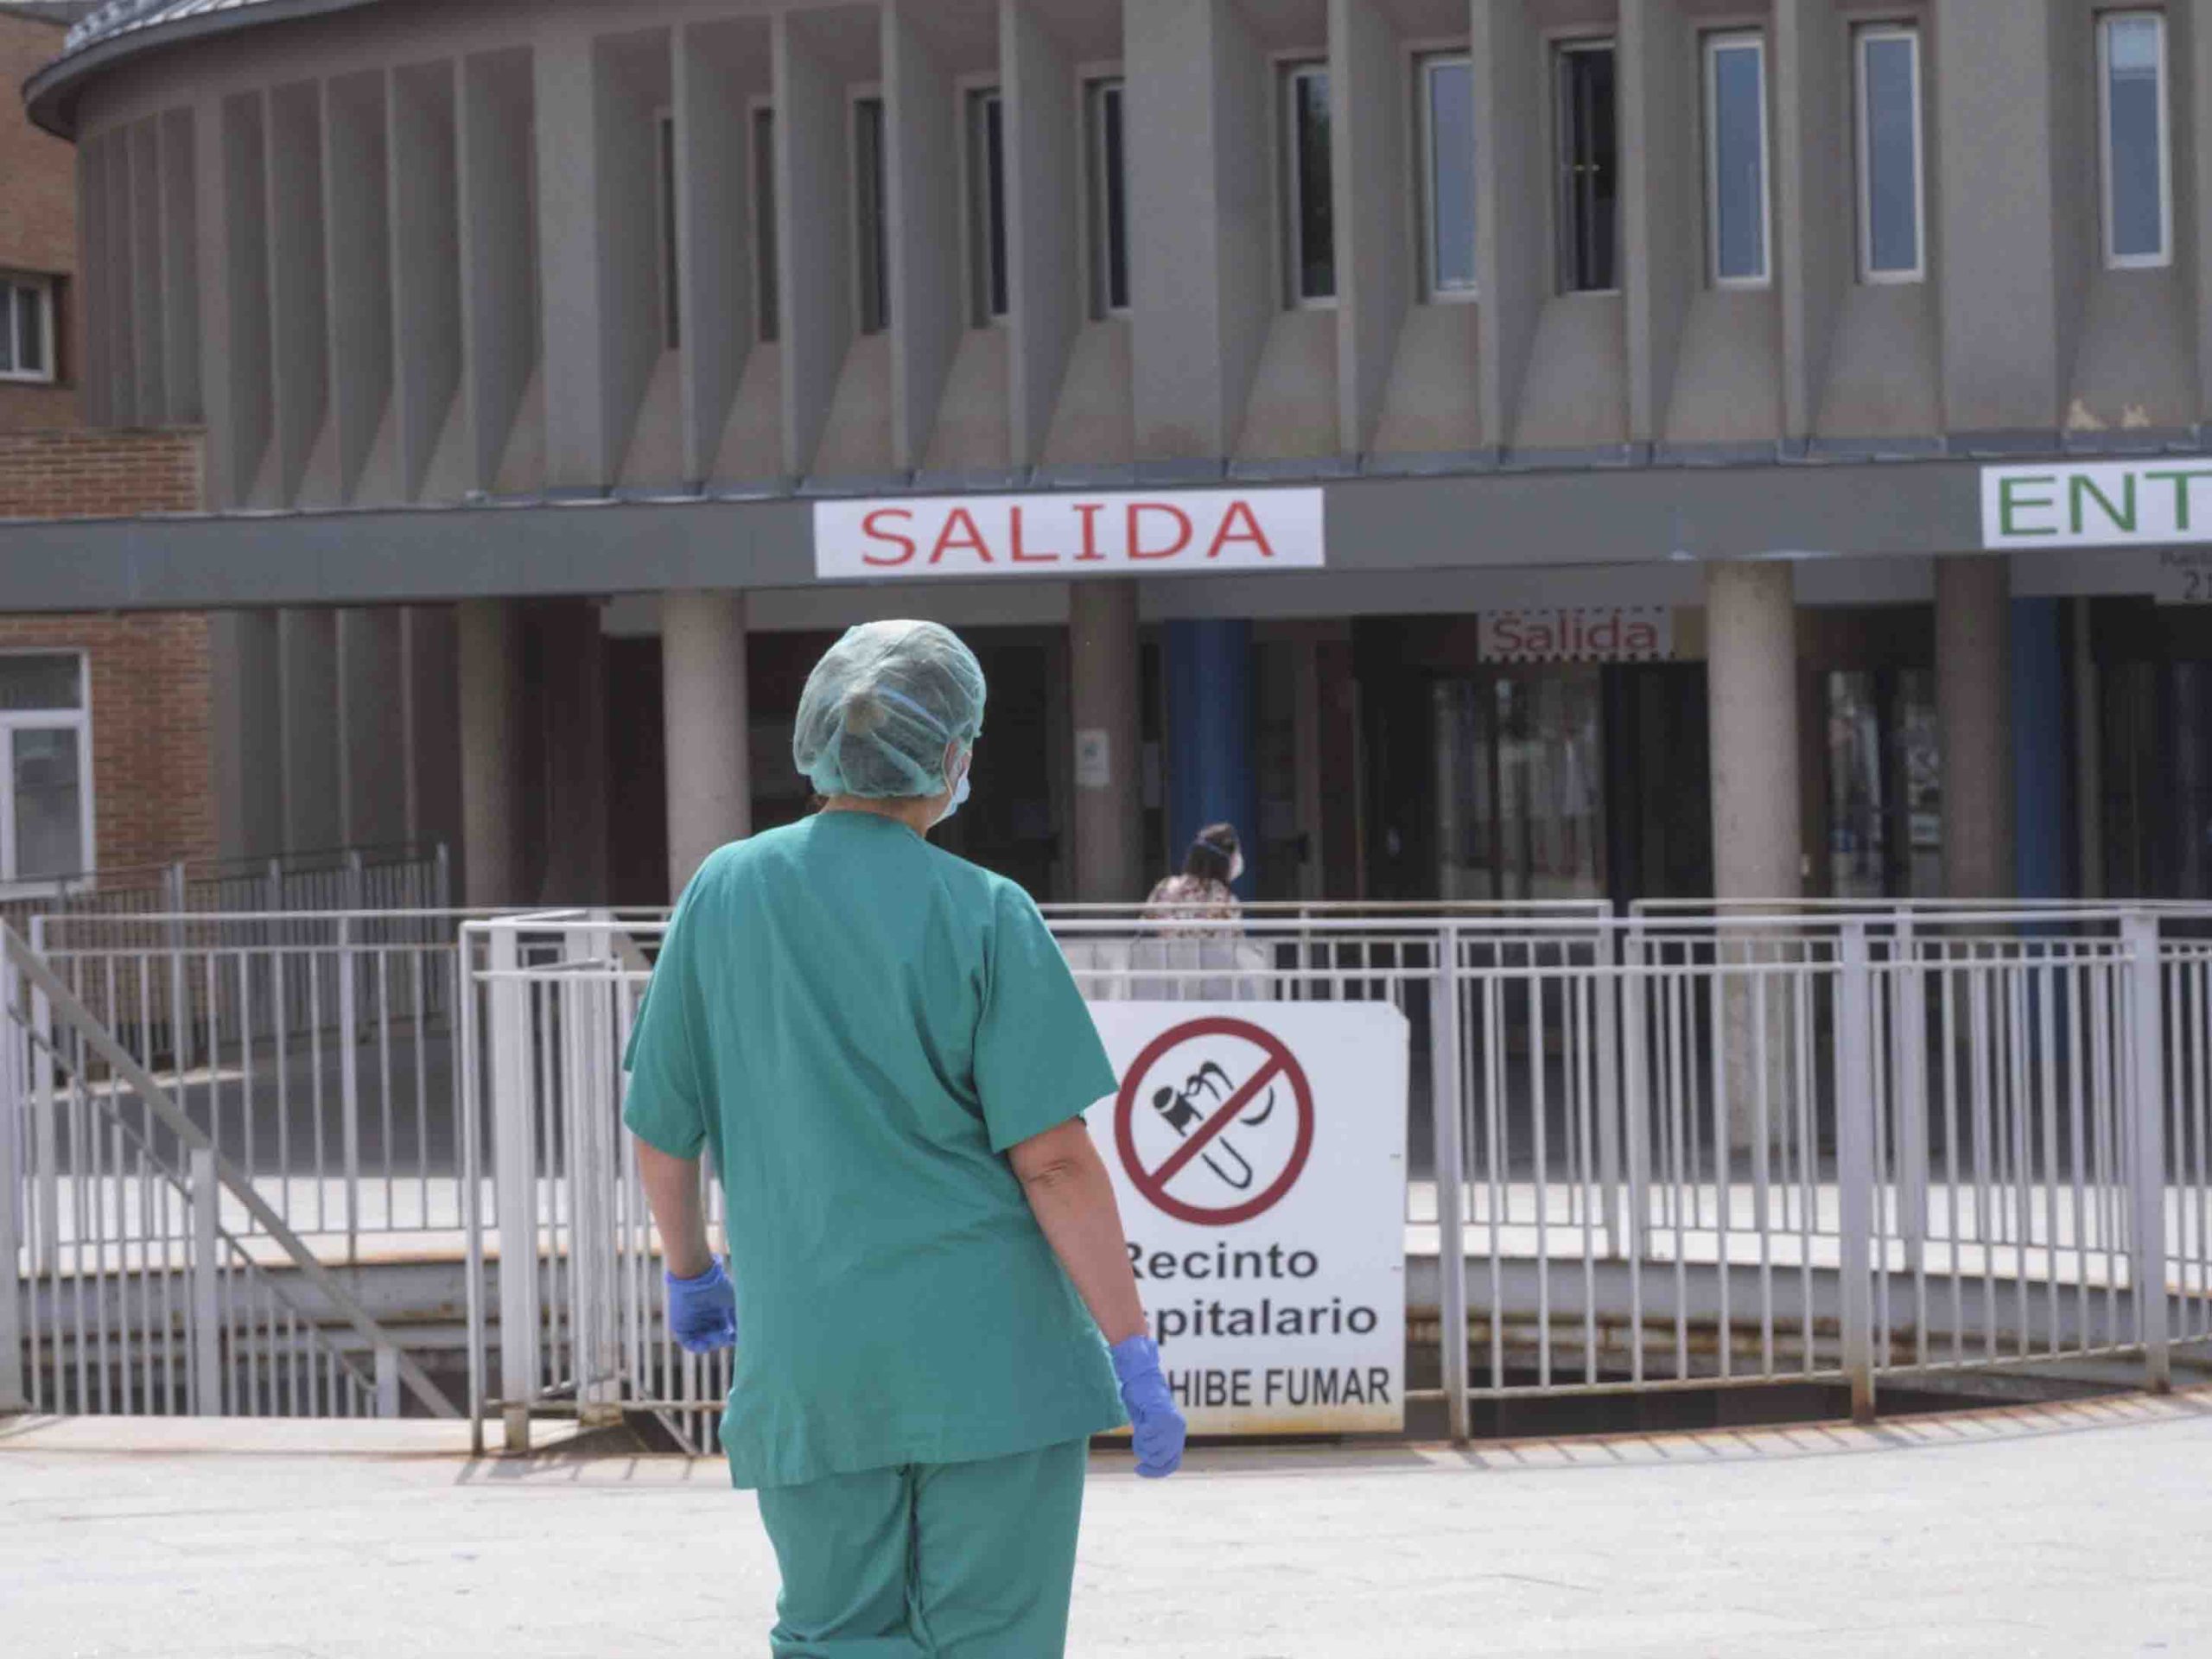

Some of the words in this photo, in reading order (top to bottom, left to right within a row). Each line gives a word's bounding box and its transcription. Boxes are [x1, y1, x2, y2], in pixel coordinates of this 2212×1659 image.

[1999, 469, 2212, 536] ENT
[861, 500, 1274, 567] SALIDA
[1493, 608, 1659, 652] Salida
[1143, 1296, 1377, 1345] pitalario
[1265, 1367, 1391, 1406] FUMAR
